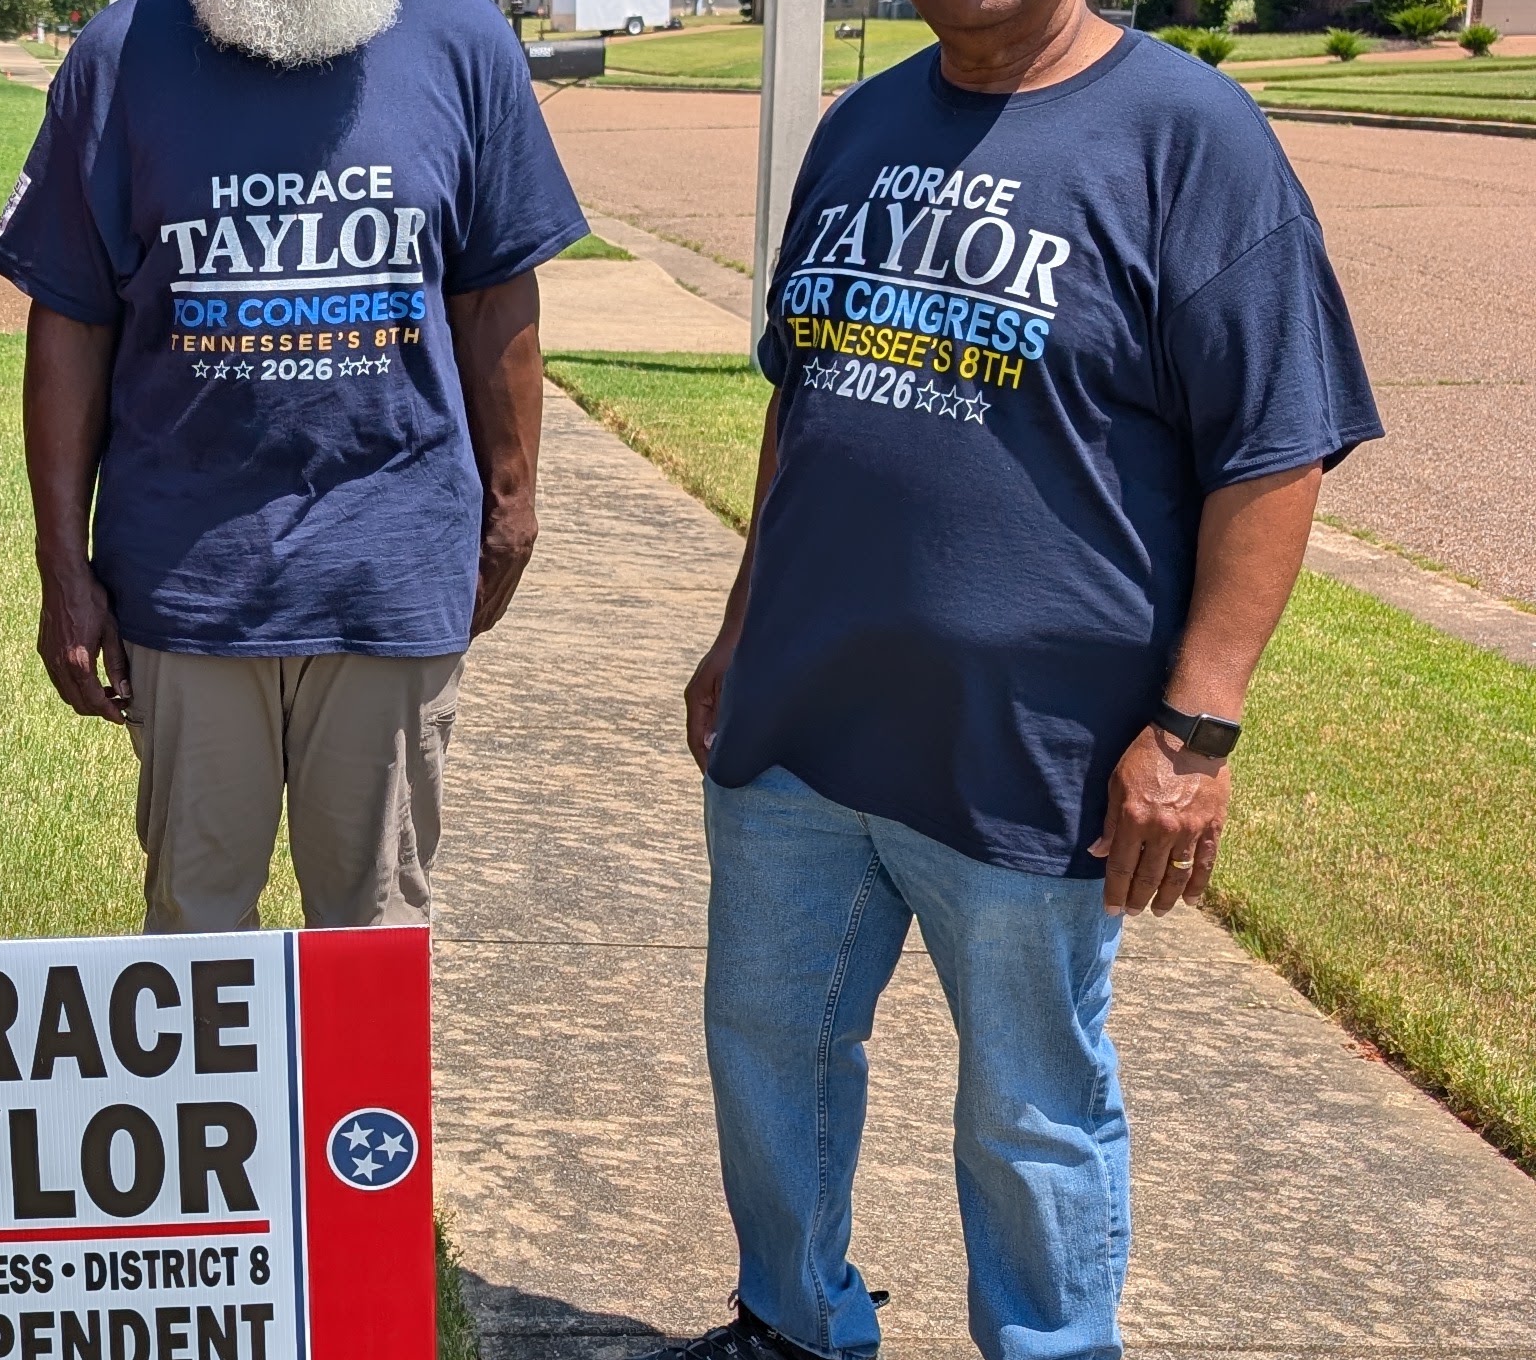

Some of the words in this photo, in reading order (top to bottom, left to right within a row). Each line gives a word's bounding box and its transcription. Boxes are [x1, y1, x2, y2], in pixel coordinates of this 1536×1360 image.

[212, 165, 394, 208] HORACE
[869, 165, 1021, 216] HORACE
[160, 207, 426, 274] TAYLOR
[801, 202, 1071, 307] TAYLOR
[237, 291, 426, 327] CONGRESS
[782, 277, 834, 316] FOR
[845, 281, 1050, 360] CONGRESS
[374, 327, 420, 347] 8TH
[260, 358, 333, 380] 2026
[836, 359, 917, 409] 2026
[959, 346, 1024, 389] 8TH
[84, 1246, 239, 1292] DISTRICT
[249, 1245, 270, 1286] 8
